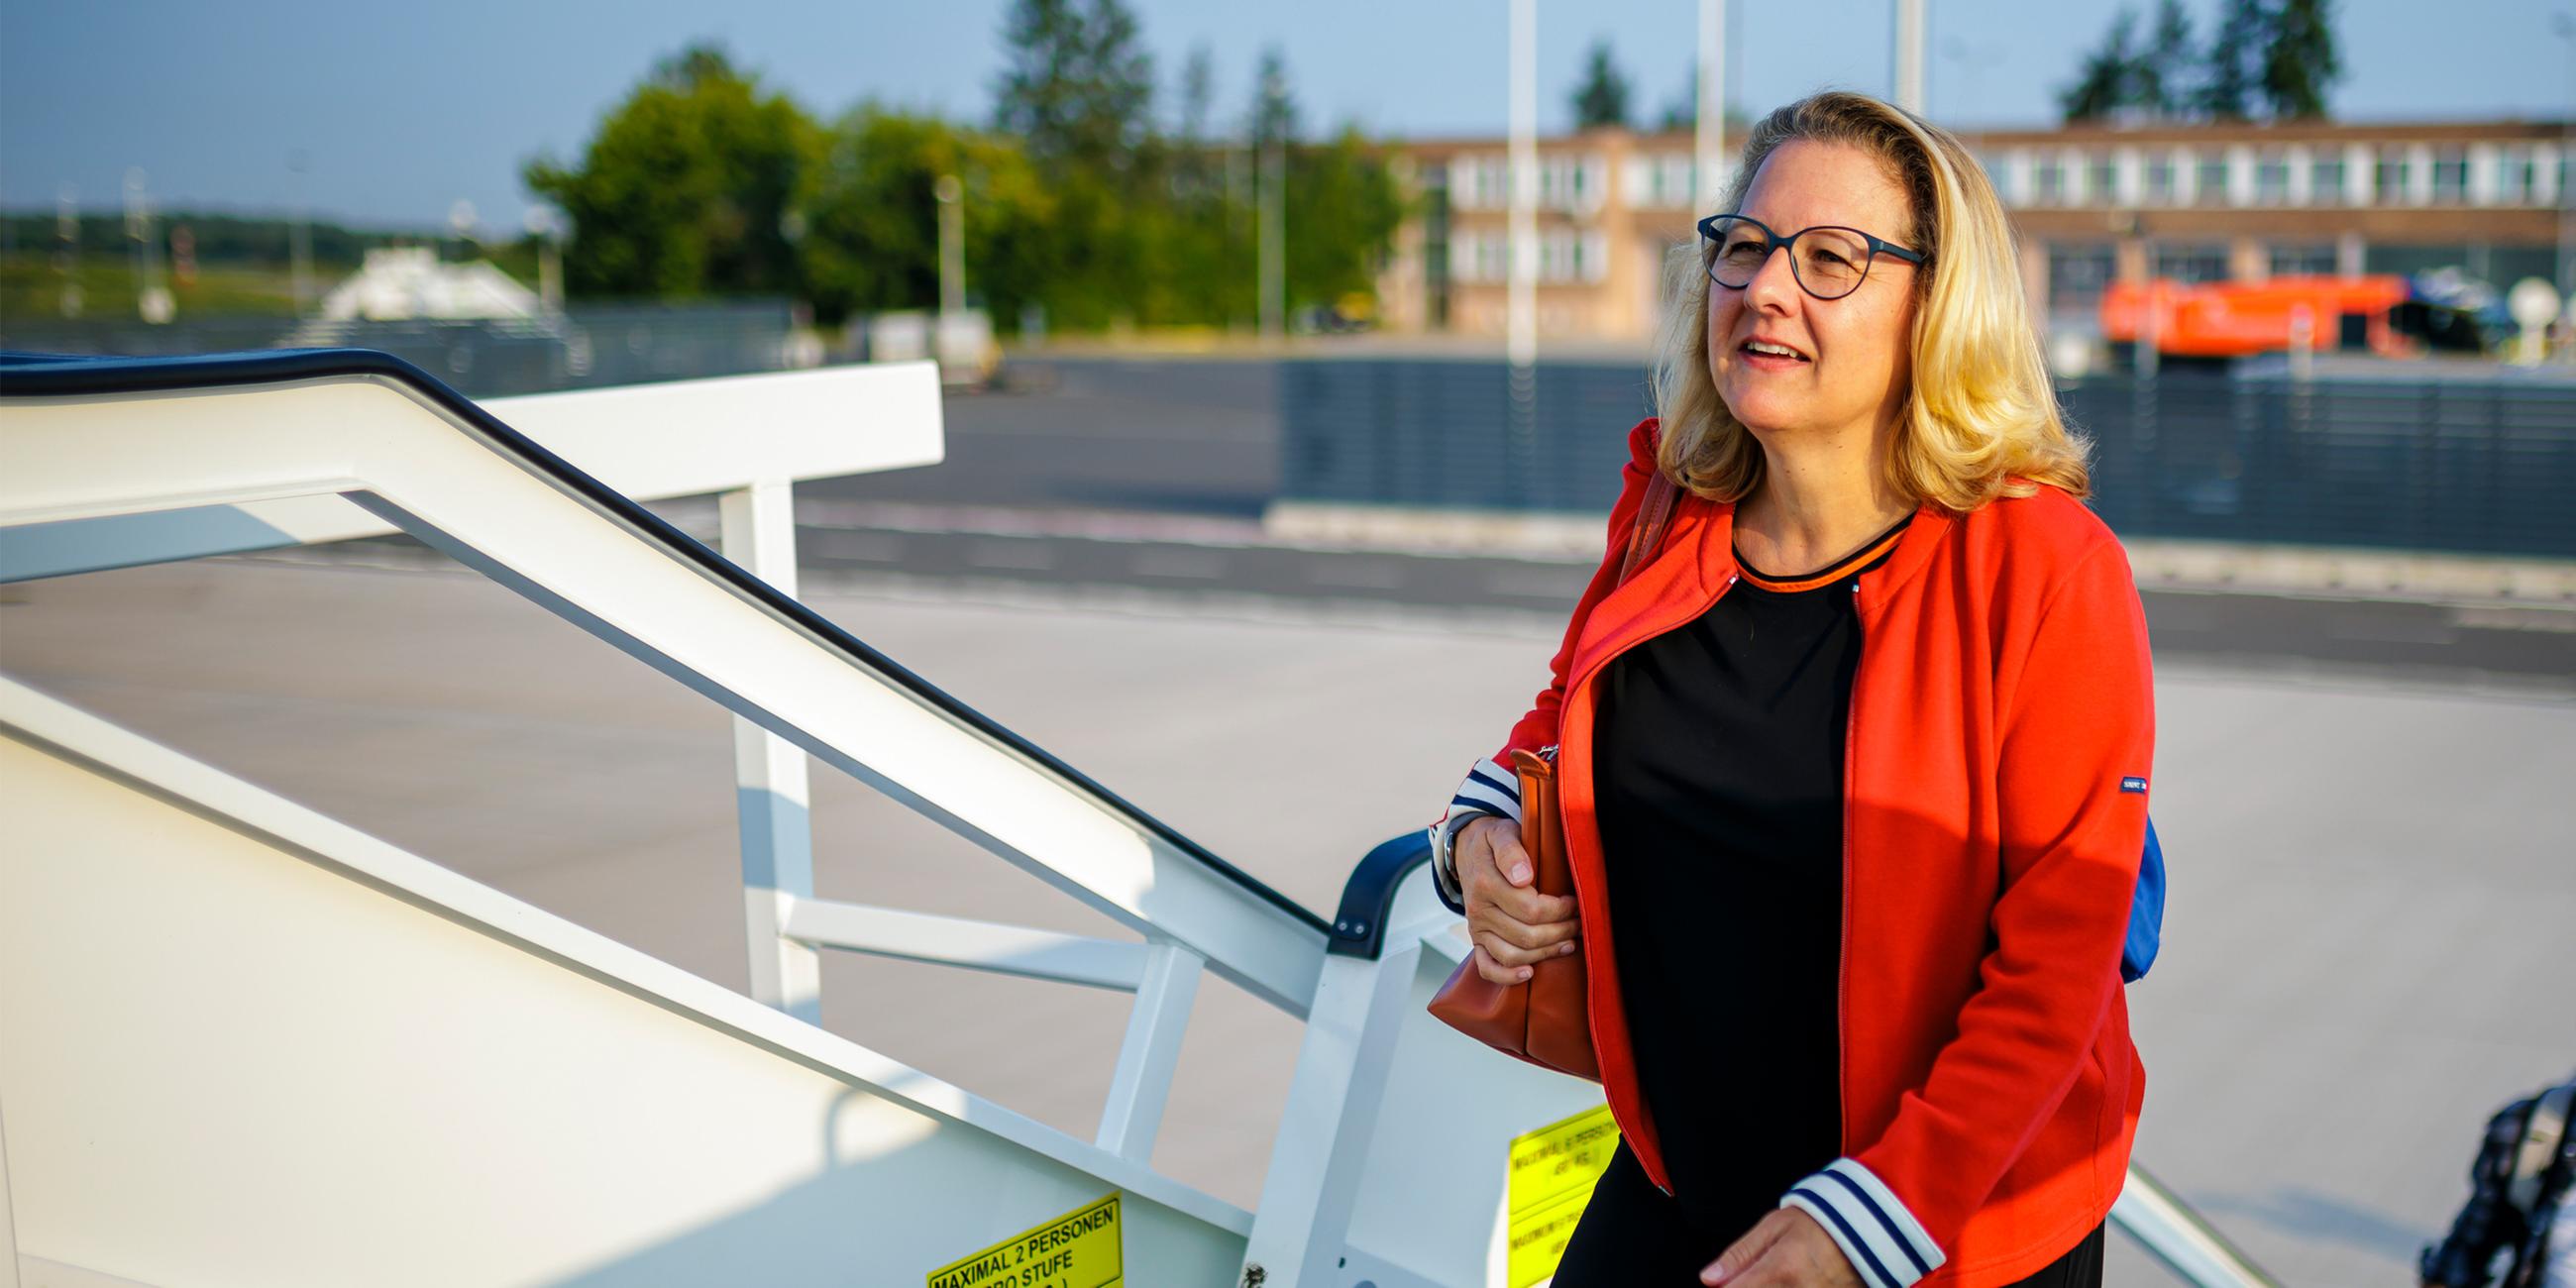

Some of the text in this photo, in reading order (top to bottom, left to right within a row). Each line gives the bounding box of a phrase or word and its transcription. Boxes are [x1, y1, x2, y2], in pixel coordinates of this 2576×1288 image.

[934, 1206, 1114, 1288] MAXIMAL 2 PERSONEN
[1021, 1249, 1074, 1287] STUFE
